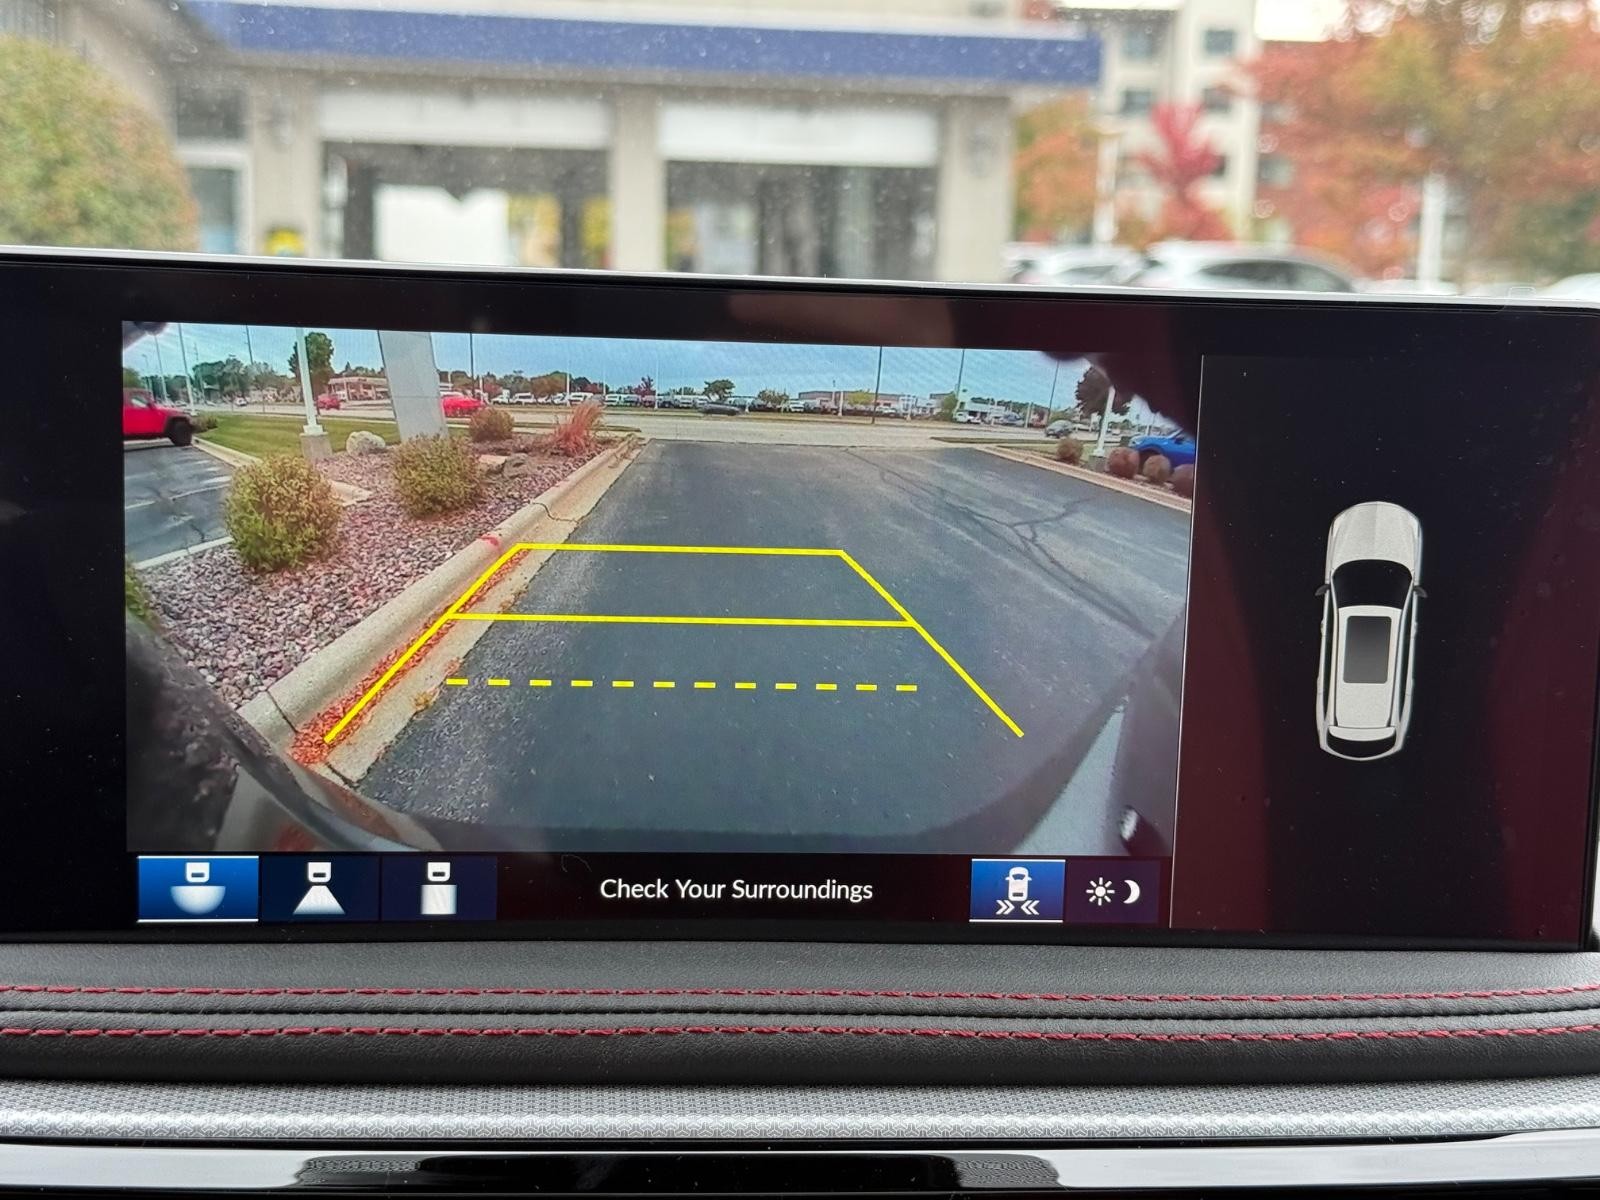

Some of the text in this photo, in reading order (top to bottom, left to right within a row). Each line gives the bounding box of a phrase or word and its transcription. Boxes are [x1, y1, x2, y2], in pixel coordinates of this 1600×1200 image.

[600, 878, 873, 903] Check Your Surroundings
